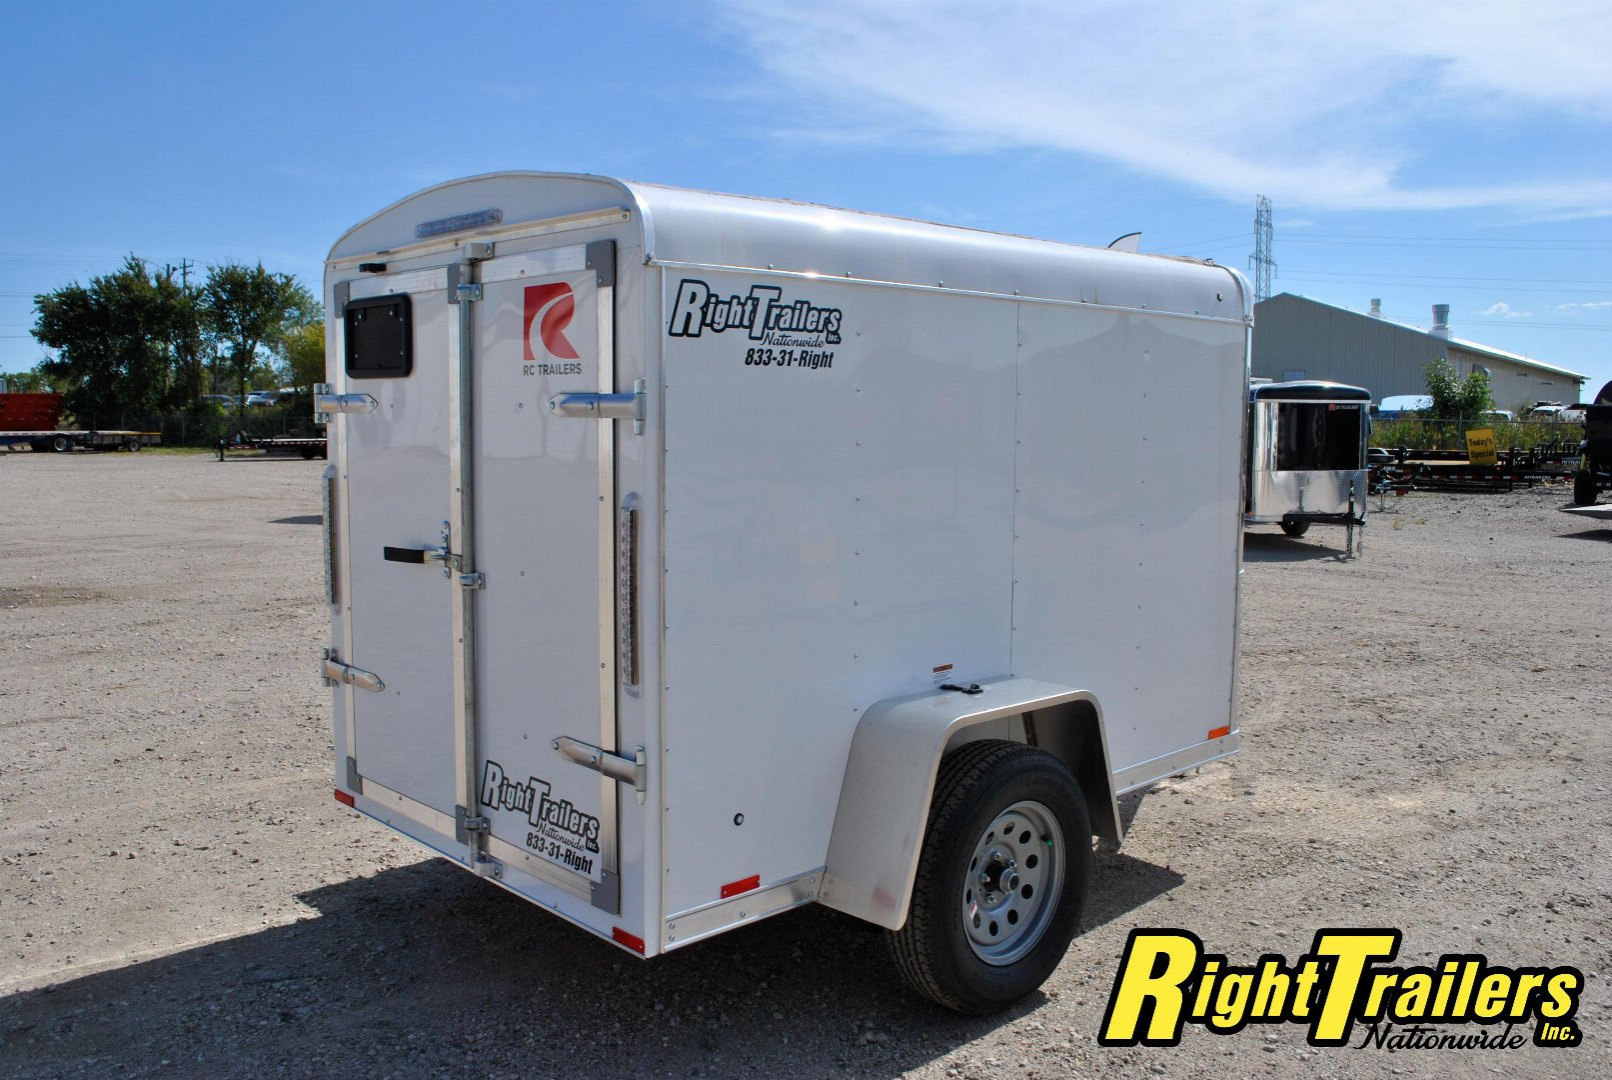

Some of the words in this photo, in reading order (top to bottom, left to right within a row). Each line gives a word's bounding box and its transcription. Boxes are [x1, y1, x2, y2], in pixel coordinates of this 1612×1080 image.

[760, 331, 825, 348] Nationwide
[745, 348, 834, 369] 833-31-Right
[523, 364, 535, 376] RC
[537, 363, 582, 376] TRAILERS
[1468, 437, 1494, 447] Today's
[1471, 449, 1495, 459] Special
[536, 822, 586, 852] Nationwide
[526, 832, 593, 874] 833-31-Right
